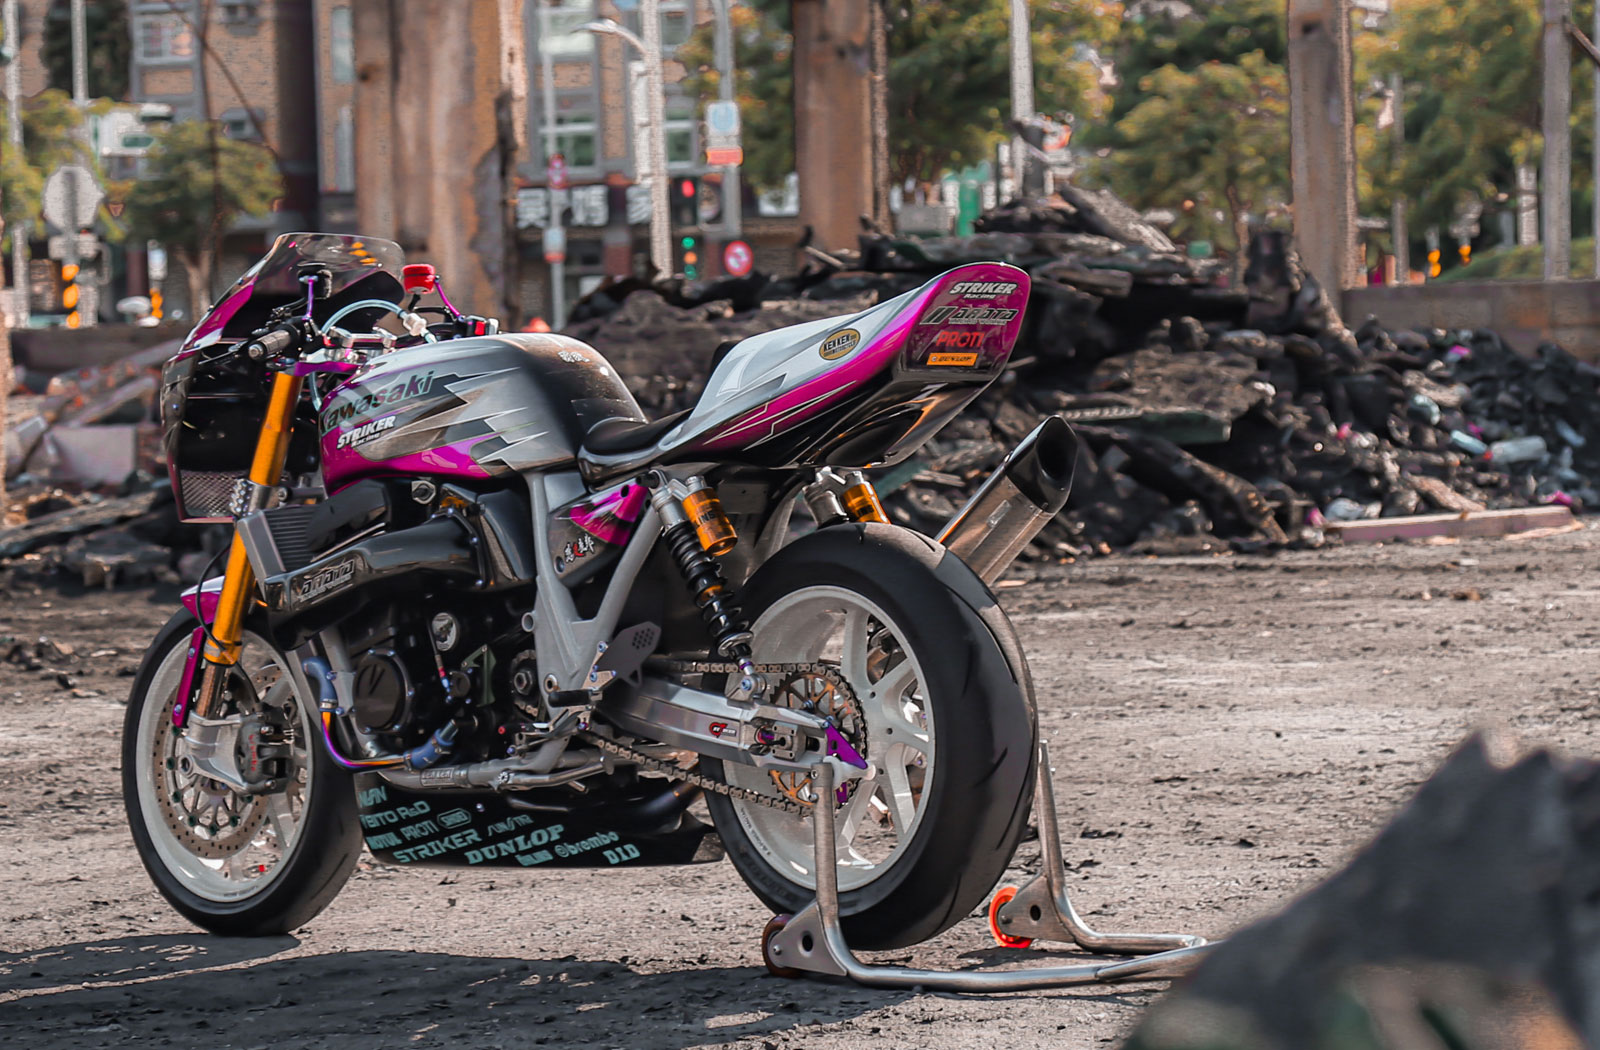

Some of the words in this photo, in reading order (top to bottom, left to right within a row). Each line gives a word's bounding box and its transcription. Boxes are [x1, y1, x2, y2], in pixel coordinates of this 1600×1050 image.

[949, 282, 1018, 295] STRIKER
[935, 331, 985, 348] PROTI
[318, 369, 435, 437] Kawasaki
[336, 415, 396, 450] STRIKER
[392, 828, 482, 863] STRIKER
[400, 820, 440, 841] PROTI
[464, 824, 565, 865] DUNLOP
[565, 831, 620, 856] brembo
